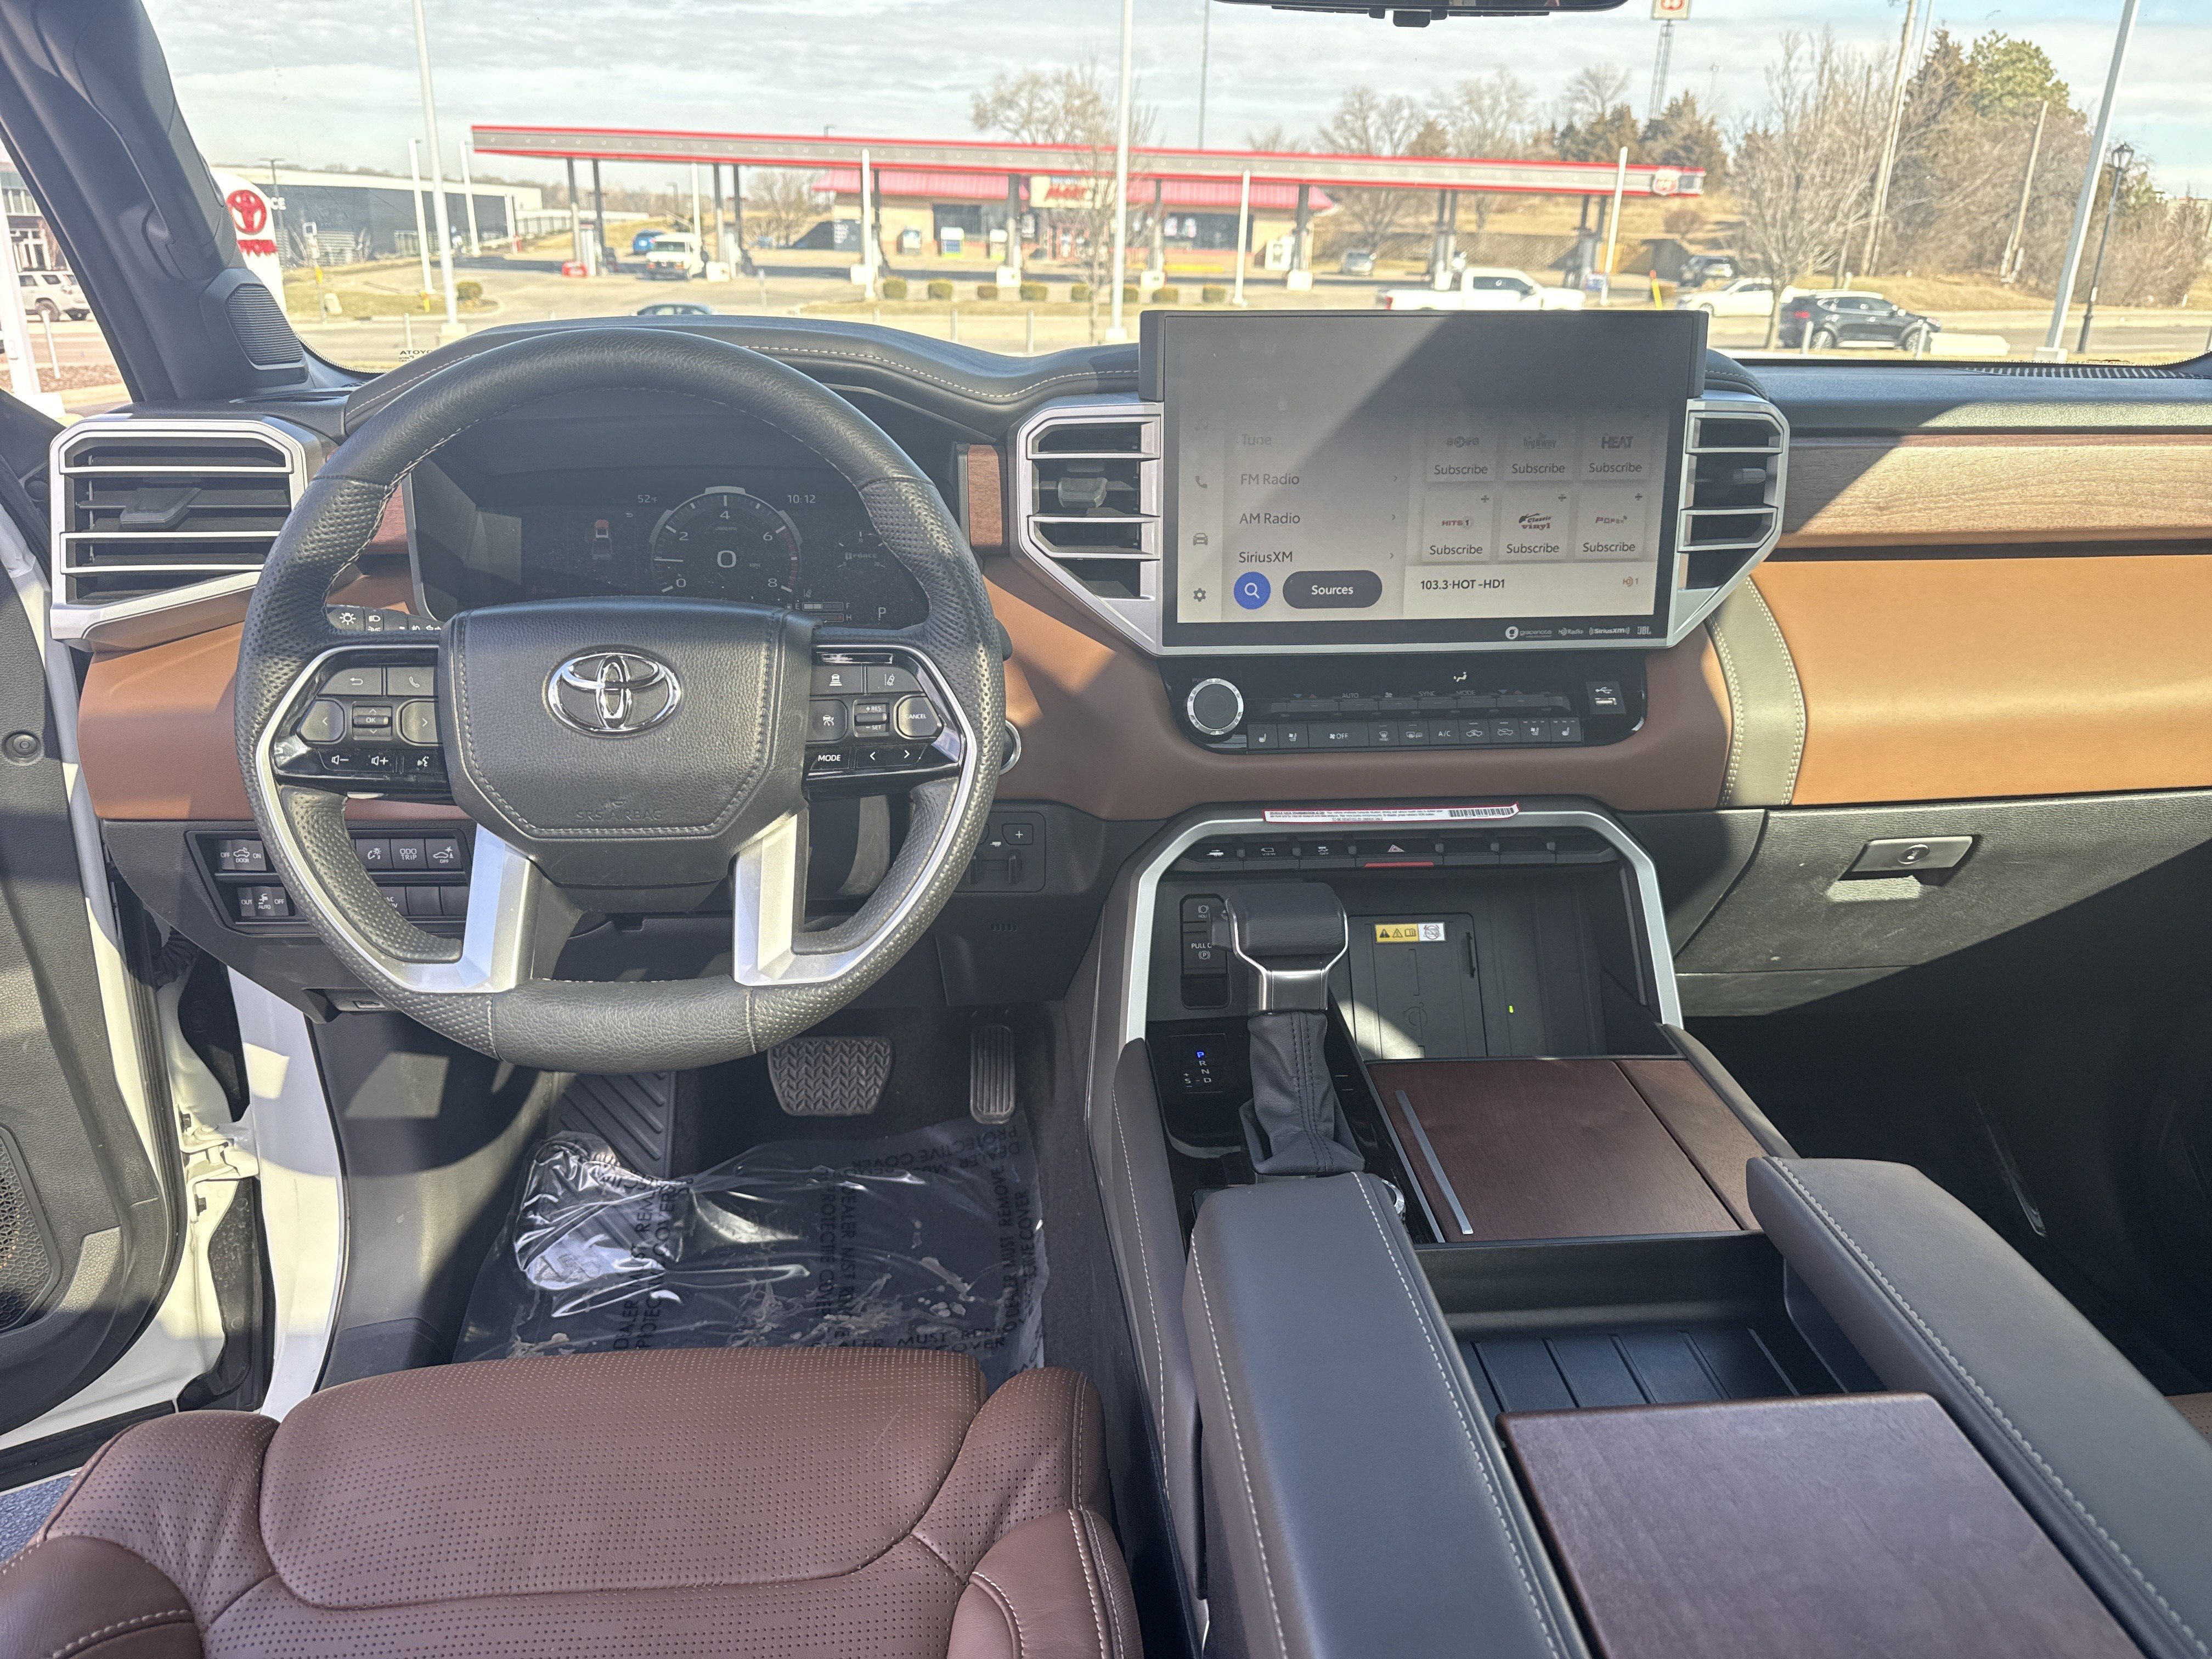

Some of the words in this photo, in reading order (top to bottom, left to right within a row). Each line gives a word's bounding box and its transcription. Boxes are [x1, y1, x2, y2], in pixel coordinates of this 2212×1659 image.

[1601, 436, 1634, 449] HEAT
[1434, 465, 1488, 475] Subscribe
[1512, 464, 1565, 473] Subscribe
[1589, 462, 1642, 473] Subscribe
[1240, 474, 1259, 485] FM
[1263, 473, 1300, 485] Radio
[787, 495, 816, 504] 10:12
[720, 511, 730, 520] 4
[1239, 513, 1260, 524] AM
[1263, 512, 1300, 524] Radio
[679, 532, 689, 541] 2
[763, 532, 773, 541] 6
[1430, 545, 1482, 555] Subscribe
[1506, 544, 1559, 554] Subscribe
[1583, 543, 1635, 553] Subscribe
[717, 550, 737, 568] 0
[1238, 551, 1293, 563] SiriusXM
[768, 578, 778, 587] 8
[1311, 585, 1354, 595] Sources
[878, 607, 887, 618] P
[1637, 626, 1651, 635] JBL
[576, 810, 603, 821] SRS
[610, 809, 663, 821] AIRBAG
